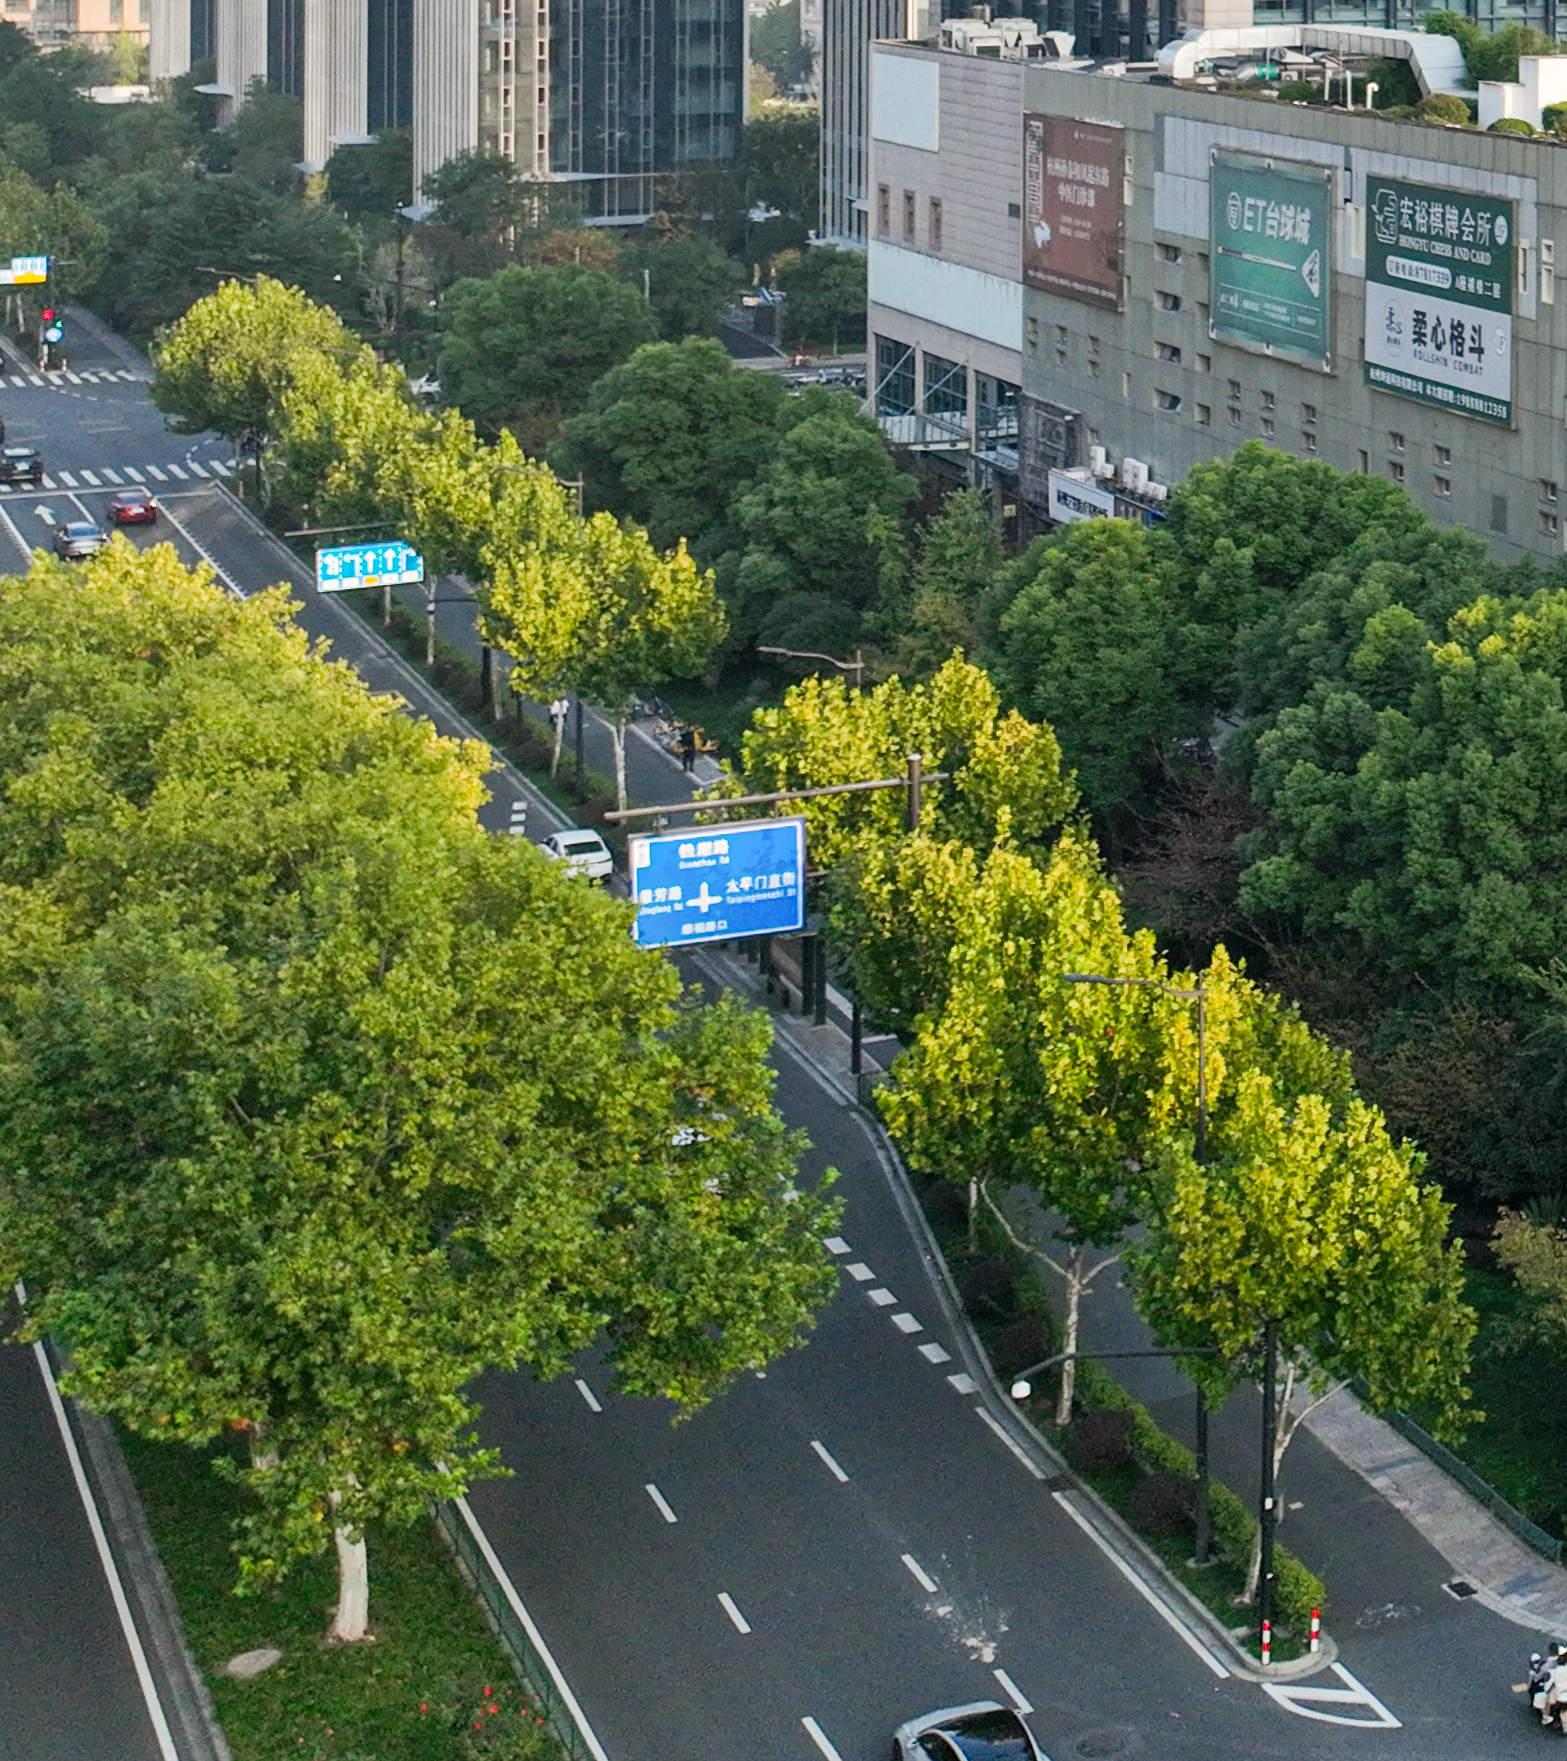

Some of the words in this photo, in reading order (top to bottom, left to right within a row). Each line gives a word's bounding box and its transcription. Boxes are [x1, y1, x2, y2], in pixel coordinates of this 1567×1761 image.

[1400, 196, 1492, 246] 宏裕棋牌会所
[1411, 309, 1485, 363] 柔心格斗
